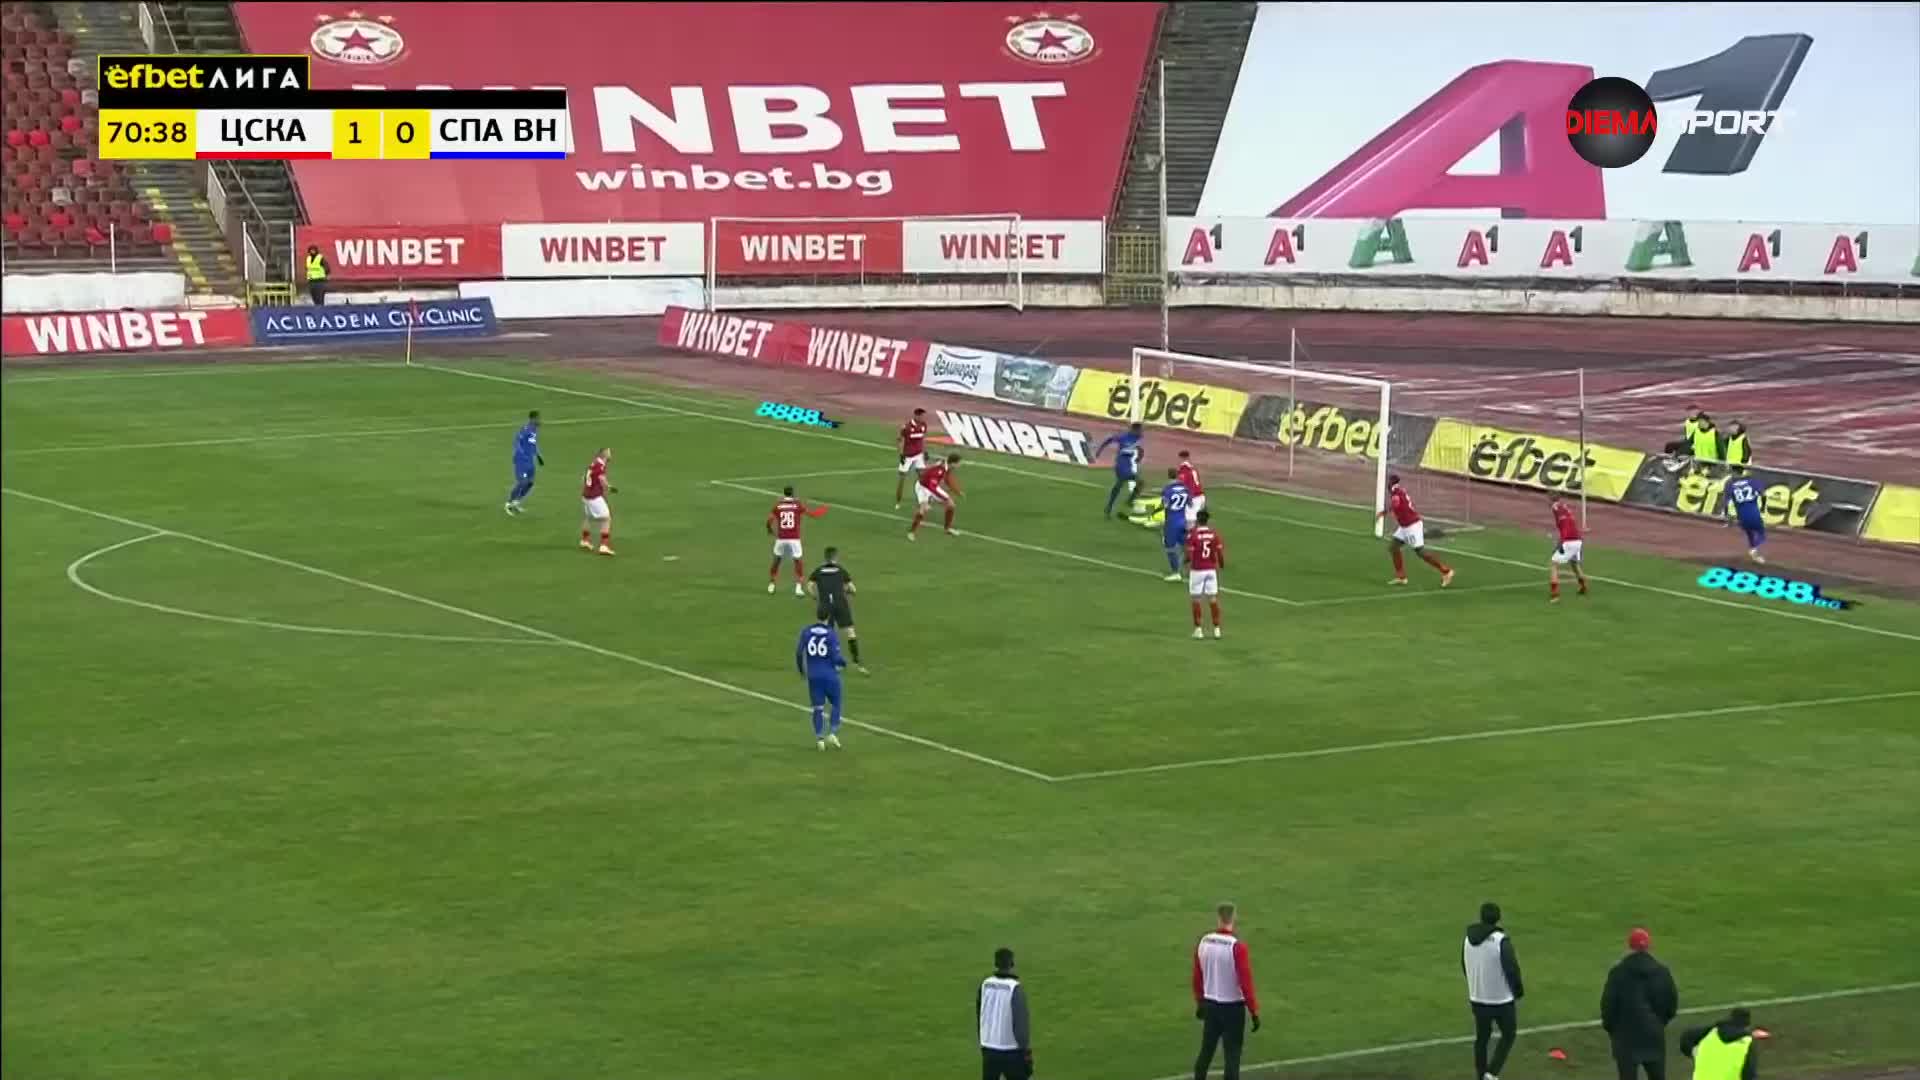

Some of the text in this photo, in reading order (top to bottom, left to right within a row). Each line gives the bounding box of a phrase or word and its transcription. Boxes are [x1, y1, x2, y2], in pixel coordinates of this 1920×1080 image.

[576, 163, 893, 195] winbet.bg
[335, 238, 465, 266] WINBET
[540, 236, 667, 263] WINBET
[741, 234, 866, 261] WINBET
[940, 234, 1065, 260] WINBET
[1182, 223, 1223, 265] A1
[1264, 224, 1305, 265] A1
[1457, 225, 1499, 267] A1
[1540, 226, 1583, 268] A1
[1737, 229, 1781, 272] A1
[1824, 231, 1869, 274] A1
[24, 311, 208, 353] WINBET
[266, 314, 379, 331] ACIBADEM
[677, 311, 773, 358] WINBET
[807, 327, 908, 378] WINBET
[936, 410, 1089, 466] WINBET
[1171, 493, 1188, 511] 27
[1733, 485, 1755, 504] 82
[780, 511, 795, 529] 28
[807, 636, 828, 656] 66
